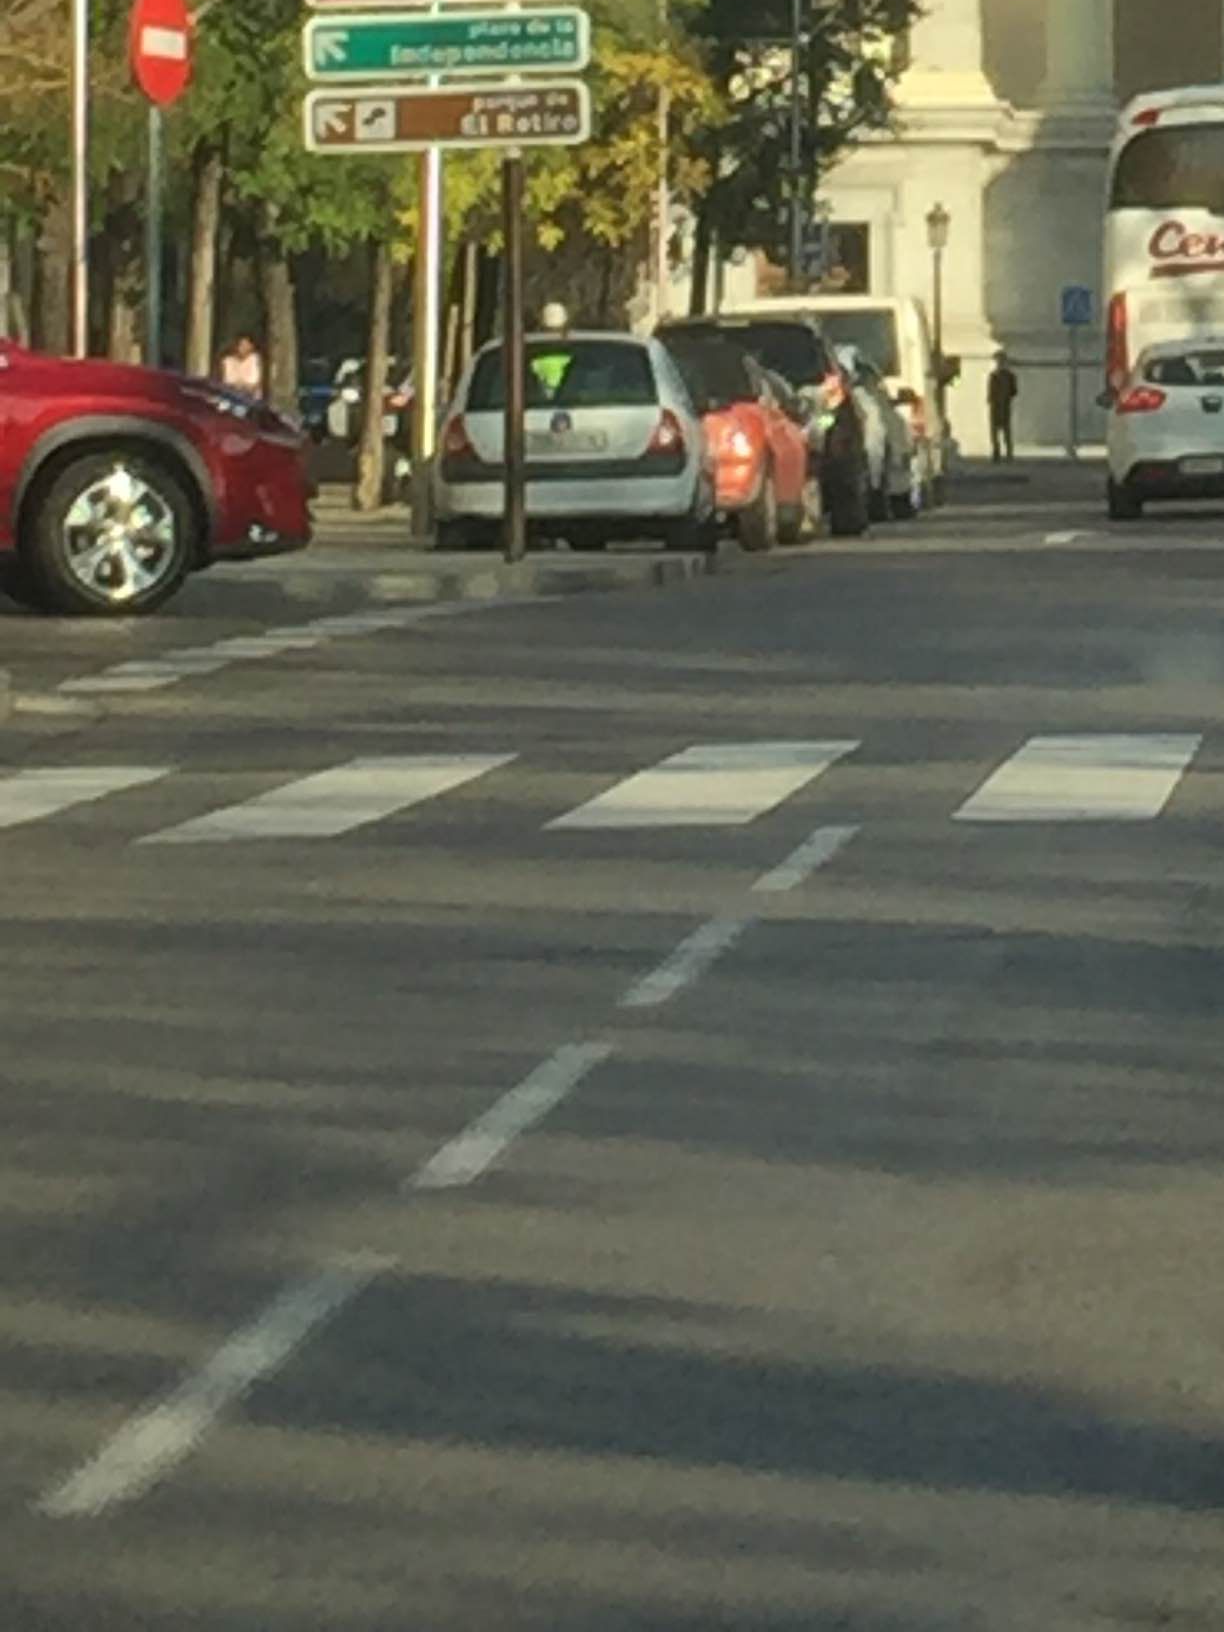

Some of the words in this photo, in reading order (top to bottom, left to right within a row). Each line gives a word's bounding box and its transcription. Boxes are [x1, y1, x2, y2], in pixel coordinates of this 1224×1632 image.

[526, 19, 551, 35] de
[555, 19, 574, 35] la
[390, 38, 574, 67] Independencia
[496, 111, 578, 134] Retiro
